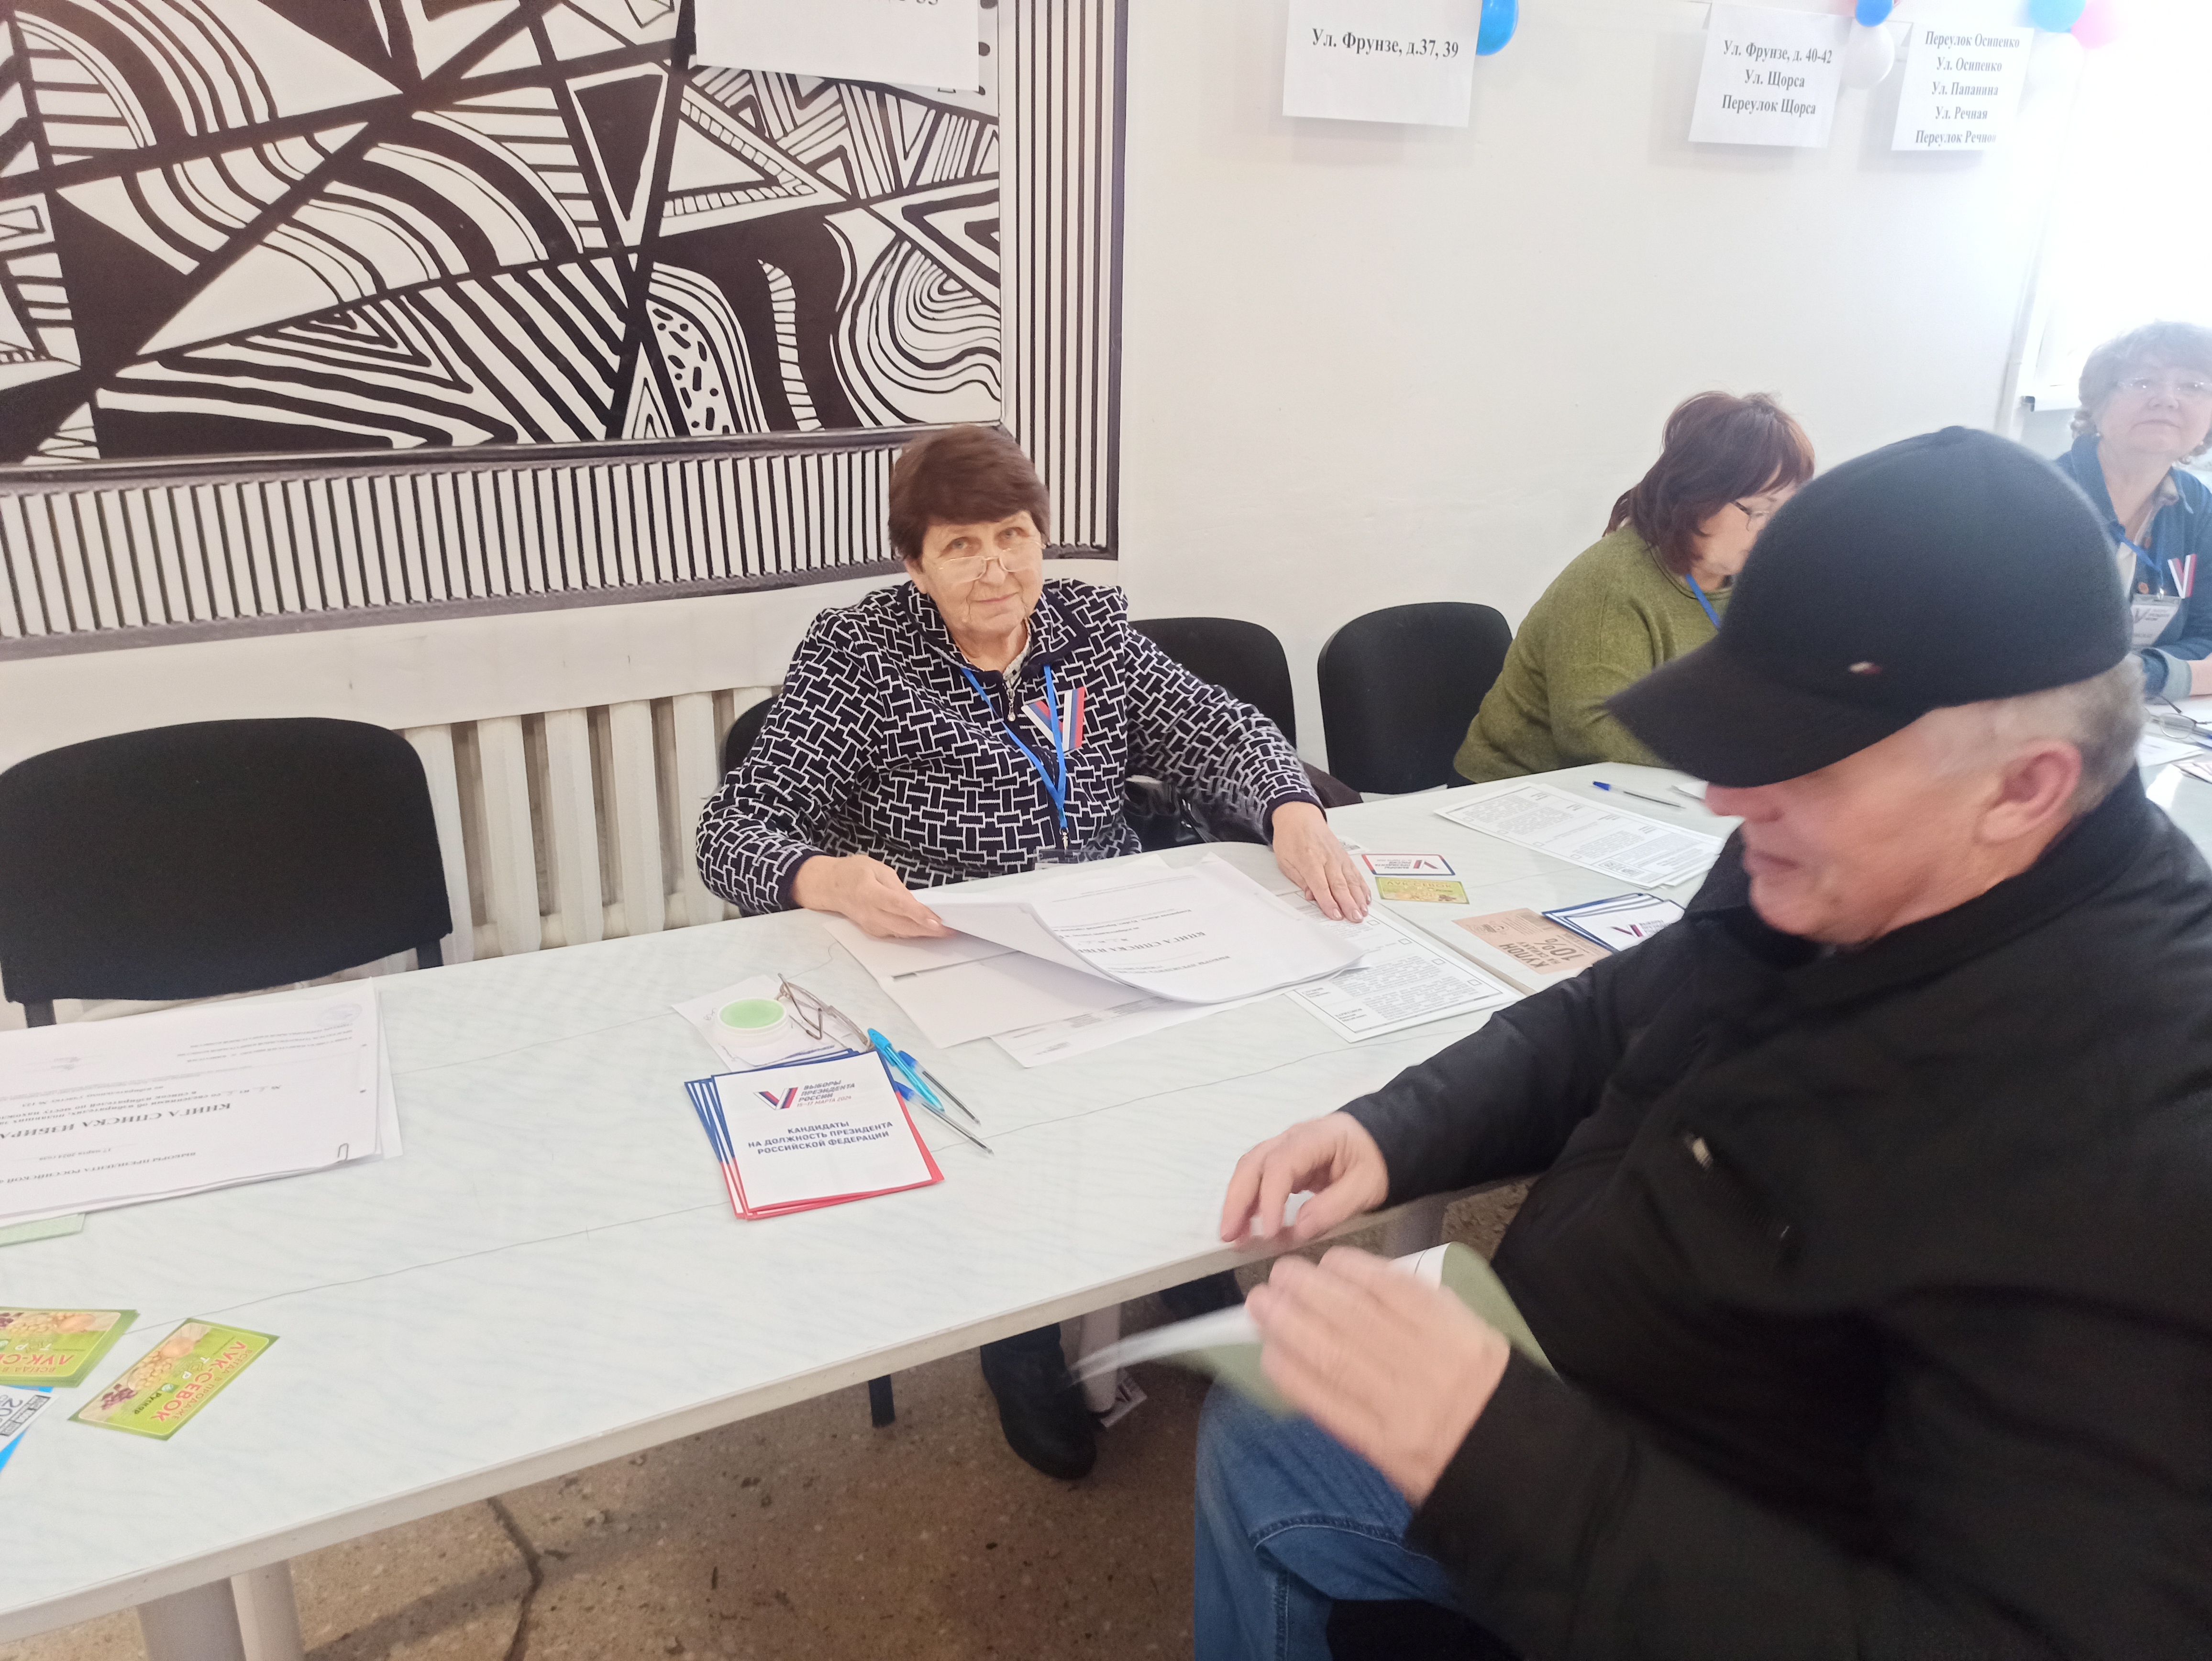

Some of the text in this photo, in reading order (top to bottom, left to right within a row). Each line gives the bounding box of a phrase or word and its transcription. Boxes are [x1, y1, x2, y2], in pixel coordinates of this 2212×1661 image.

[1312, 28, 1459, 60] Ул. Фрунзе, д.37, 39
[1924, 31, 2020, 49] Переулок Осипенко
[1723, 40, 1833, 64] Ул. Фрунзе, д. 40-42
[1936, 56, 2002, 72] Ул. Осипенко
[1745, 69, 1805, 90] Ул. Щорса
[1931, 81, 1998, 96] Ул. Папанина
[1722, 94, 1816, 118] Переулок Щорса
[1935, 106, 1988, 120] Ул. Речная
[1915, 130, 1963, 146] Переулок
[1499, 943, 1549, 968] КУПОН
[1534, 938, 1584, 961] 10%
[801, 1083, 855, 1096] ПРЕЗИДЕНТА
[804, 1080, 841, 1090] ВЫБОРЫ
[798, 1093, 833, 1102] РОССИИ
[168, 1103, 231, 1117] КНИГА
[82, 1112, 162, 1128] СПИСКА
[787, 1121, 849, 1134] КАНДИДАТЫ
[764, 1132, 828, 1146] ДОЛЖНОСТЬ
[830, 1121, 893, 1136] ПРЕЗИДЕНТА
[757, 1131, 889, 1154] РОССИЙСКОЙ ФЕДЕРАЦИИ
[150, 1341, 247, 1422] ЛУК-СЕВОК
